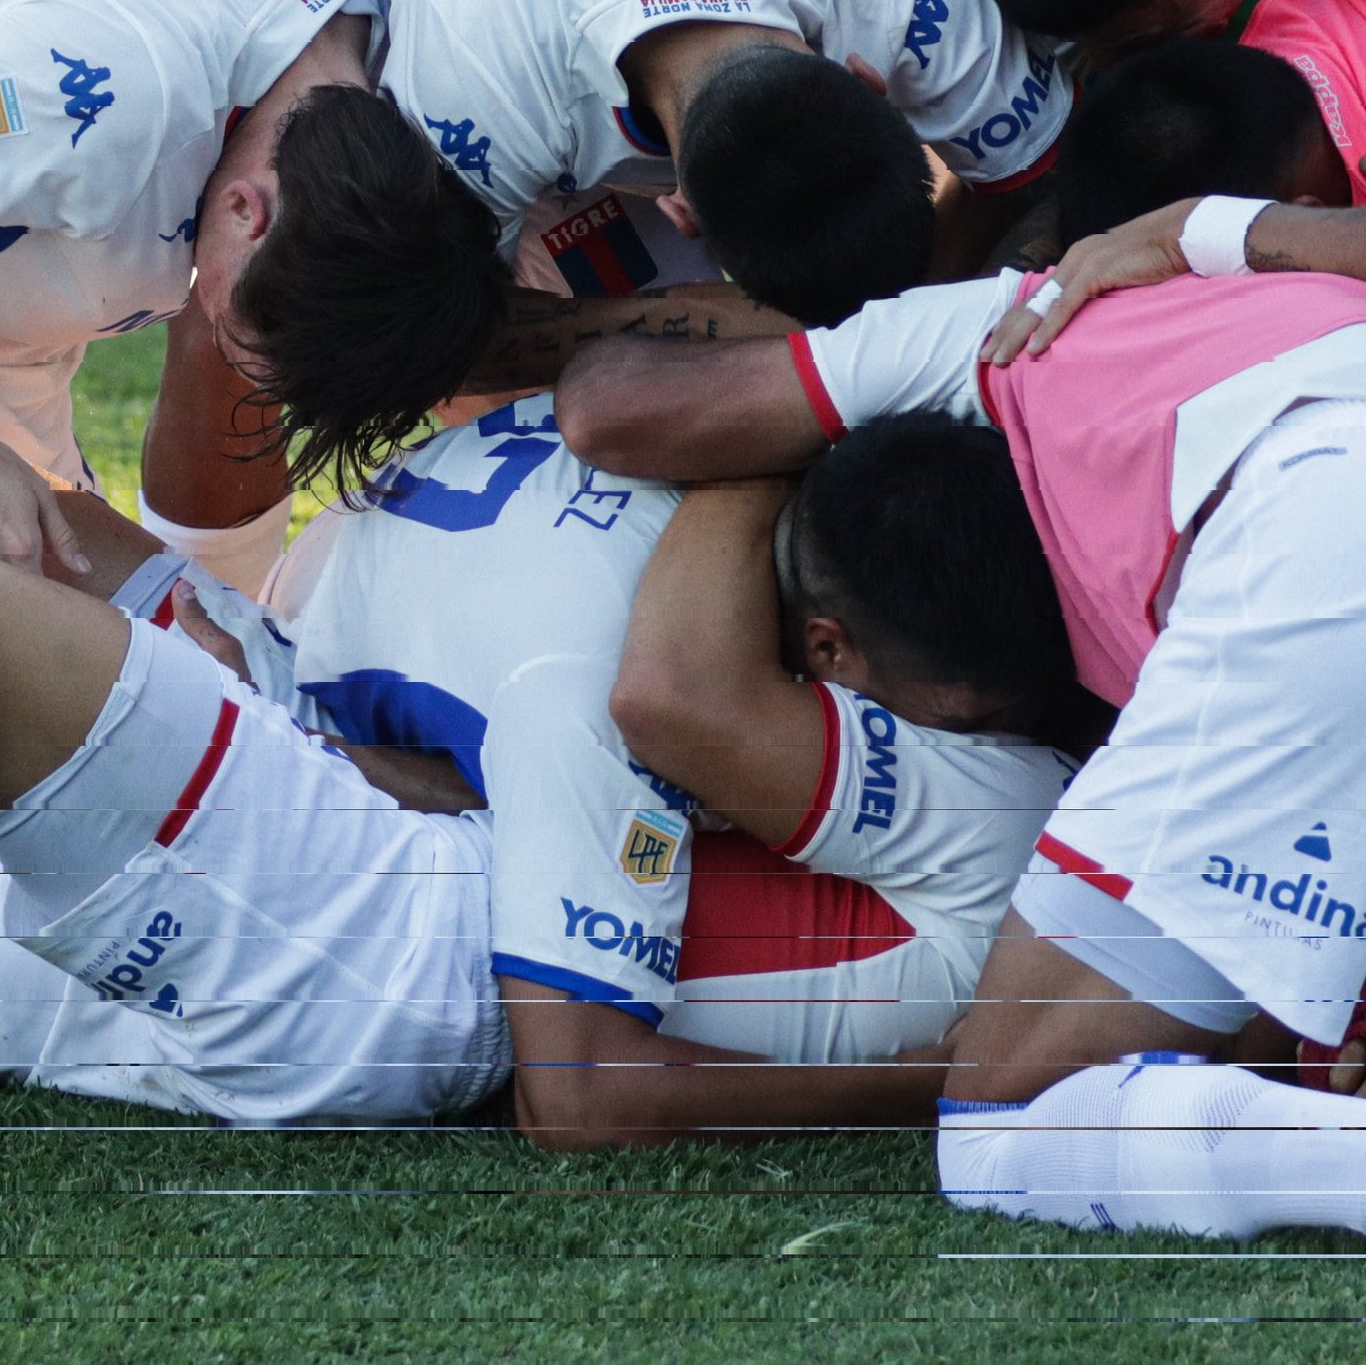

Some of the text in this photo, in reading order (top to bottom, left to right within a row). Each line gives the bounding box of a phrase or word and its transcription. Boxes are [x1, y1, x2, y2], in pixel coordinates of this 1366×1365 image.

[642, 1, 692, 19] NORTE
[695, 1, 732, 14] ZONA
[1293, 54, 1353, 148] Kappa
[547, 199, 619, 250] TIGRE
